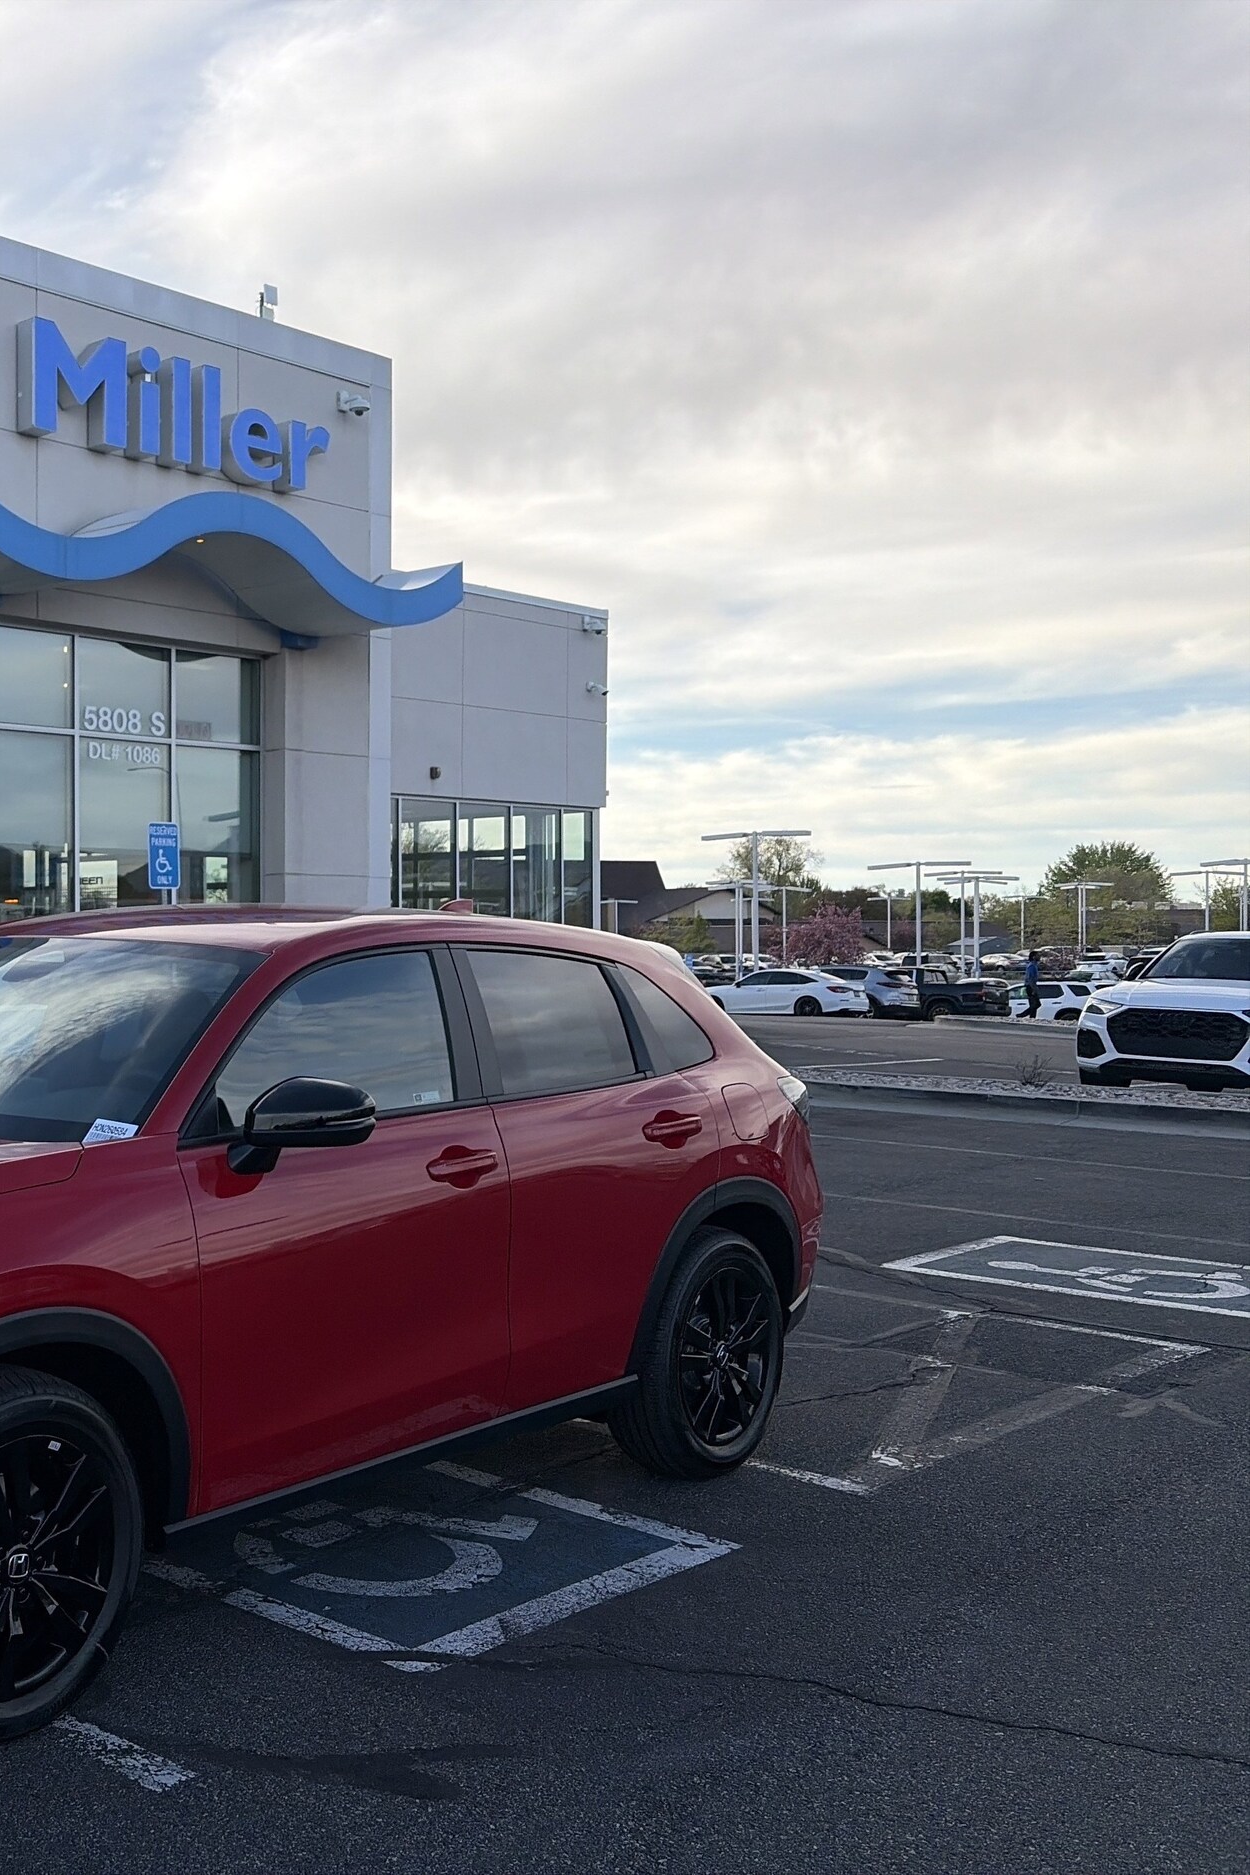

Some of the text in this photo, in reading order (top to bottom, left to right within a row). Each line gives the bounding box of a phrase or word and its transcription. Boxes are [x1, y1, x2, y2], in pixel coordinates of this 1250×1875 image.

[26, 315, 331, 491] Miller
[83, 705, 142, 734] 5808
[150, 711, 166, 736] S
[88, 741, 160, 764] DL# 1086
[149, 825, 177, 836] RESERVED
[151, 837, 176, 847] PARKING
[157, 875, 172, 885] ONLY
